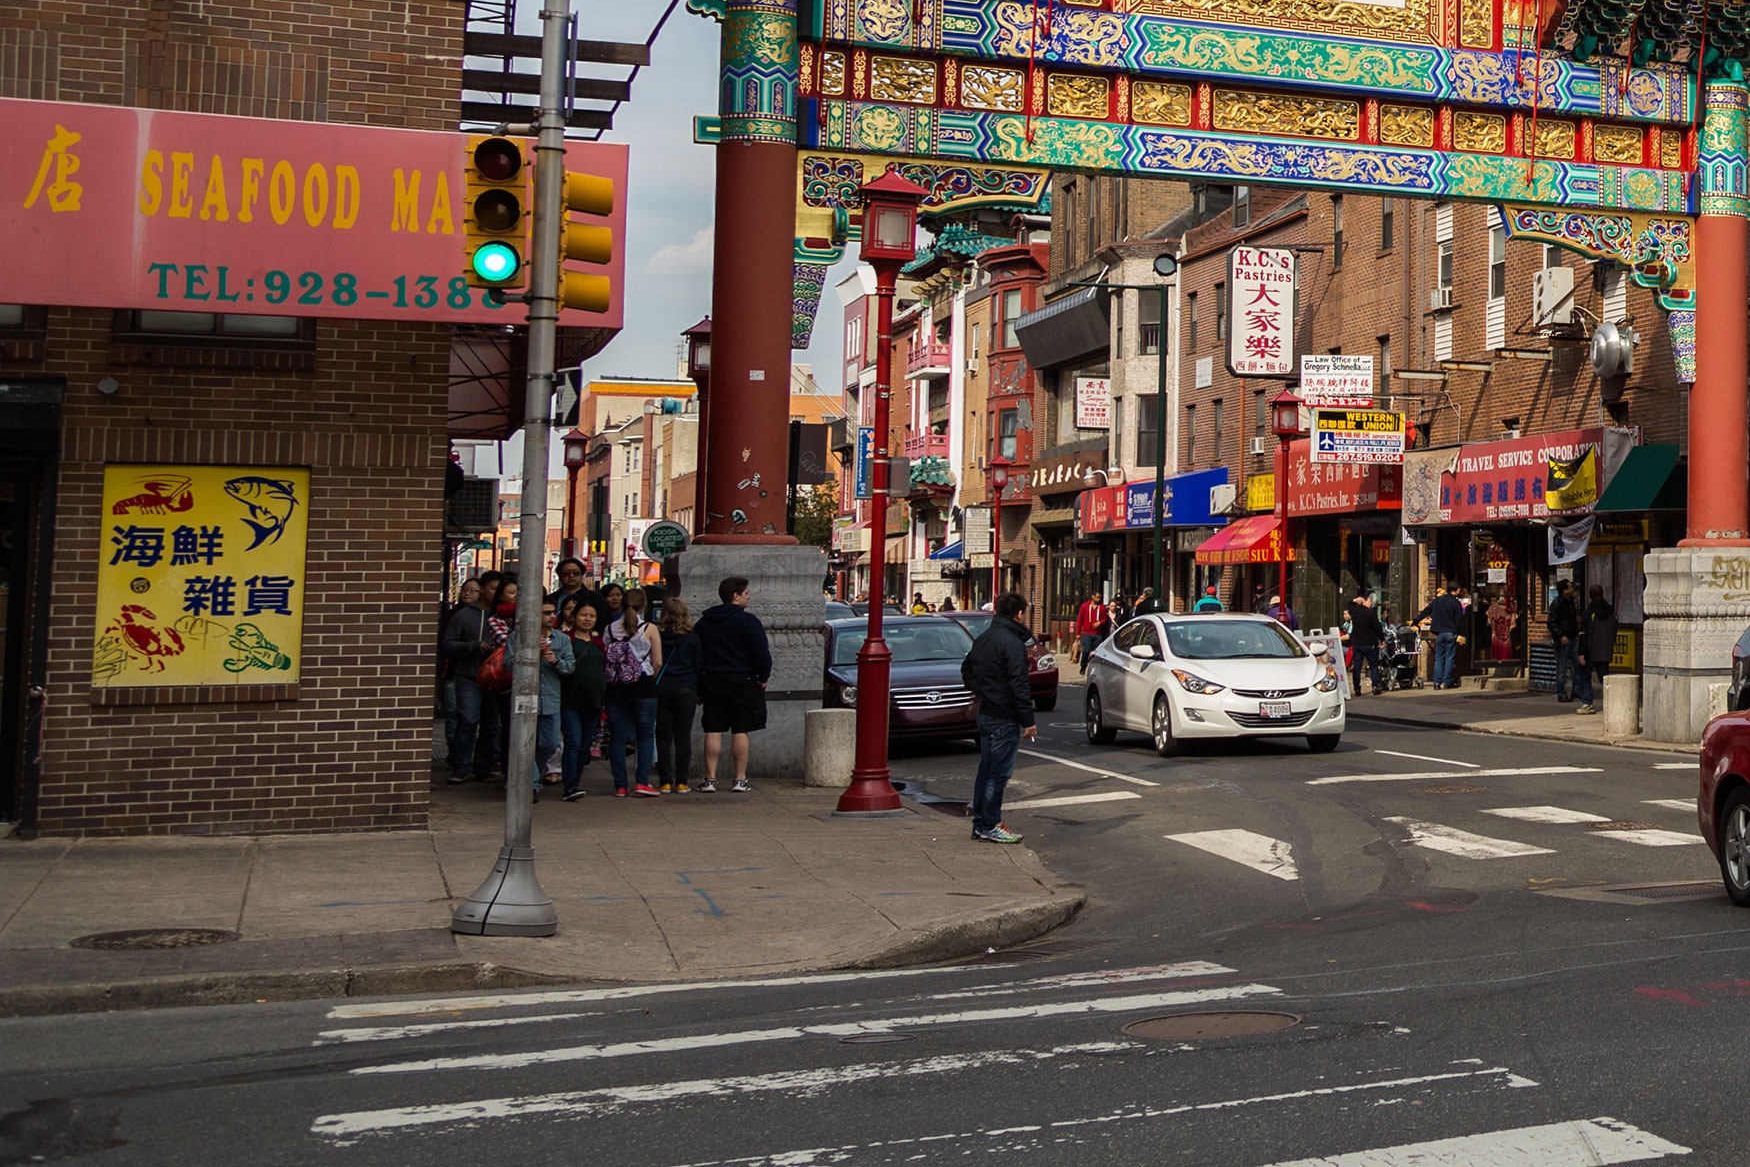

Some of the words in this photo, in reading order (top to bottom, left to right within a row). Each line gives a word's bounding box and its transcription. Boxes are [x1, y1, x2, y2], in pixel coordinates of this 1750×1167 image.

[24, 124, 83, 212] 店
[140, 149, 361, 230] SEAFOOD
[391, 168, 467, 235] MA
[1235, 268, 1292, 283] Pastries
[1245, 283, 1282, 359] 大家樂
[1304, 363, 1330, 372] Gregory
[1346, 412, 1393, 422] WESTERN
[1363, 422, 1393, 431] UNION
[1337, 453, 1400, 462] 267.519.0204
[1461, 455, 1495, 473] TRAVEL
[1497, 450, 1534, 468] SERVICE
[109, 525, 224, 567] 海鮮
[1251, 549, 1269, 561] SIU
[1488, 560, 1510, 569] 107
[182, 575, 296, 617] 雜貨
